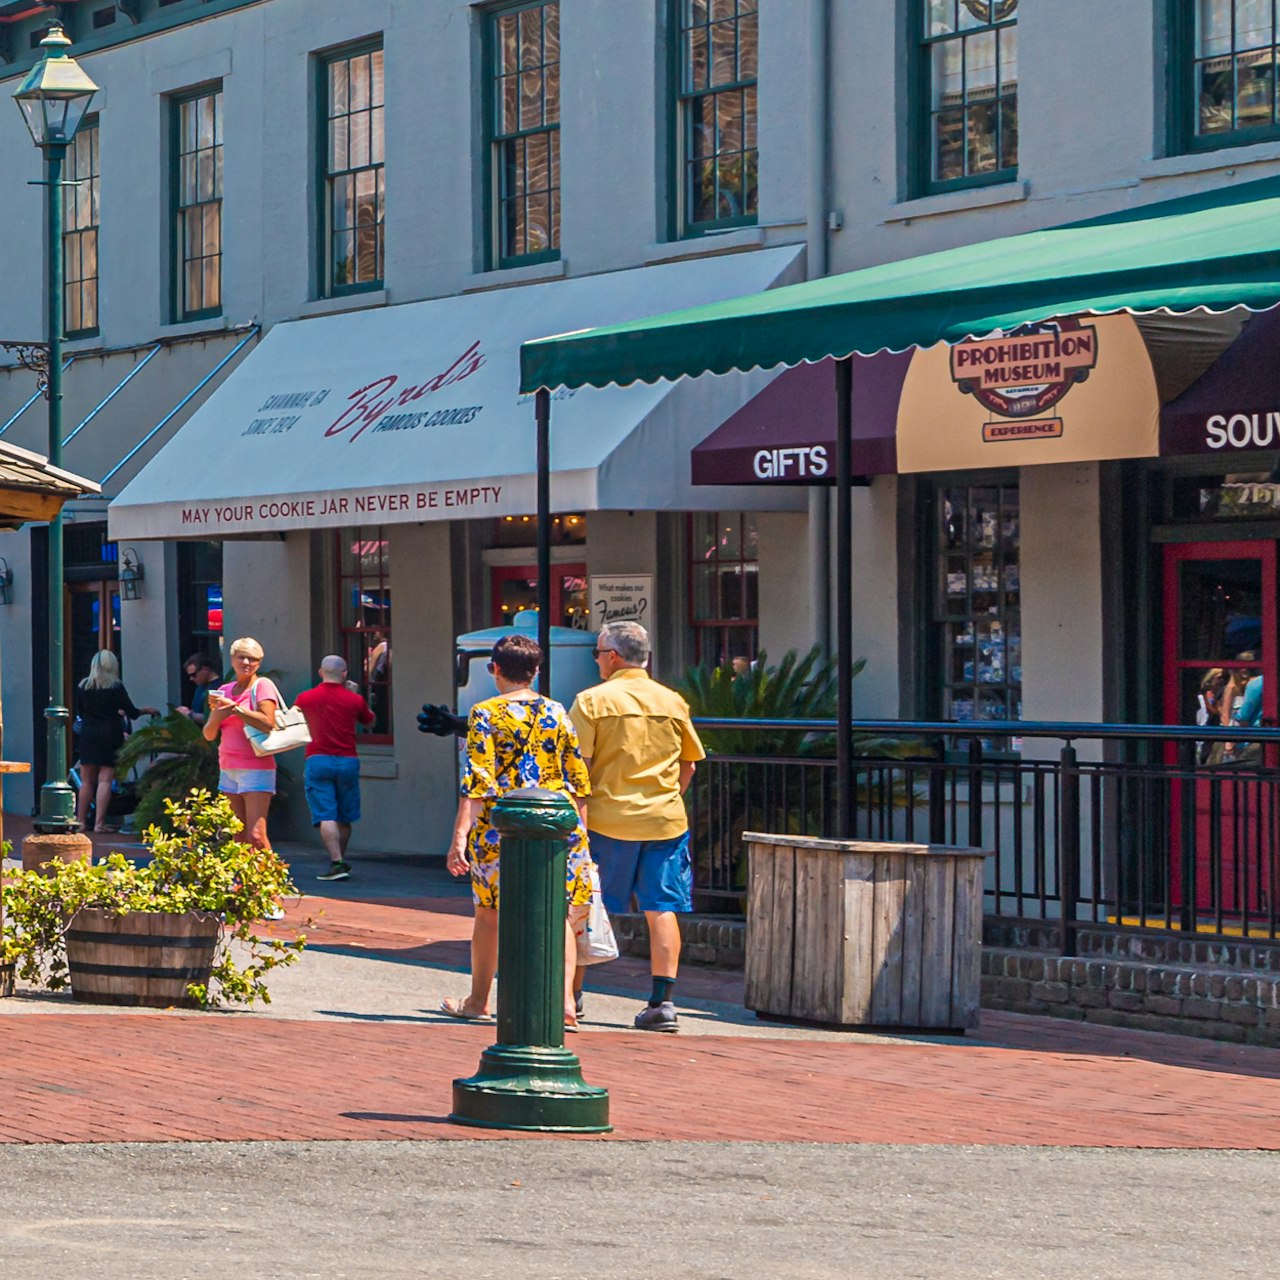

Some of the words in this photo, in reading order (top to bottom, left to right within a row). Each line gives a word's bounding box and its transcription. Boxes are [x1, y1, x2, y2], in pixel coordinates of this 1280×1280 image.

[957, 334, 1092, 367] PROHIBITION
[984, 362, 1061, 384] MUSEUM
[324, 340, 487, 443] Byrd's
[372, 411, 429, 433] FAMOUS
[424, 406, 483, 428] COOKIES
[990, 423, 1055, 437] EXPERIENCE
[753, 445, 828, 478] GIFTS
[181, 509, 210, 524] MAY
[214, 505, 253, 522] YOUR
[259, 501, 315, 519] COOKIE
[320, 498, 349, 515] JAR
[355, 494, 410, 512] NEVER
[416, 492, 438, 509] BE
[445, 487, 502, 506] EMPTY
